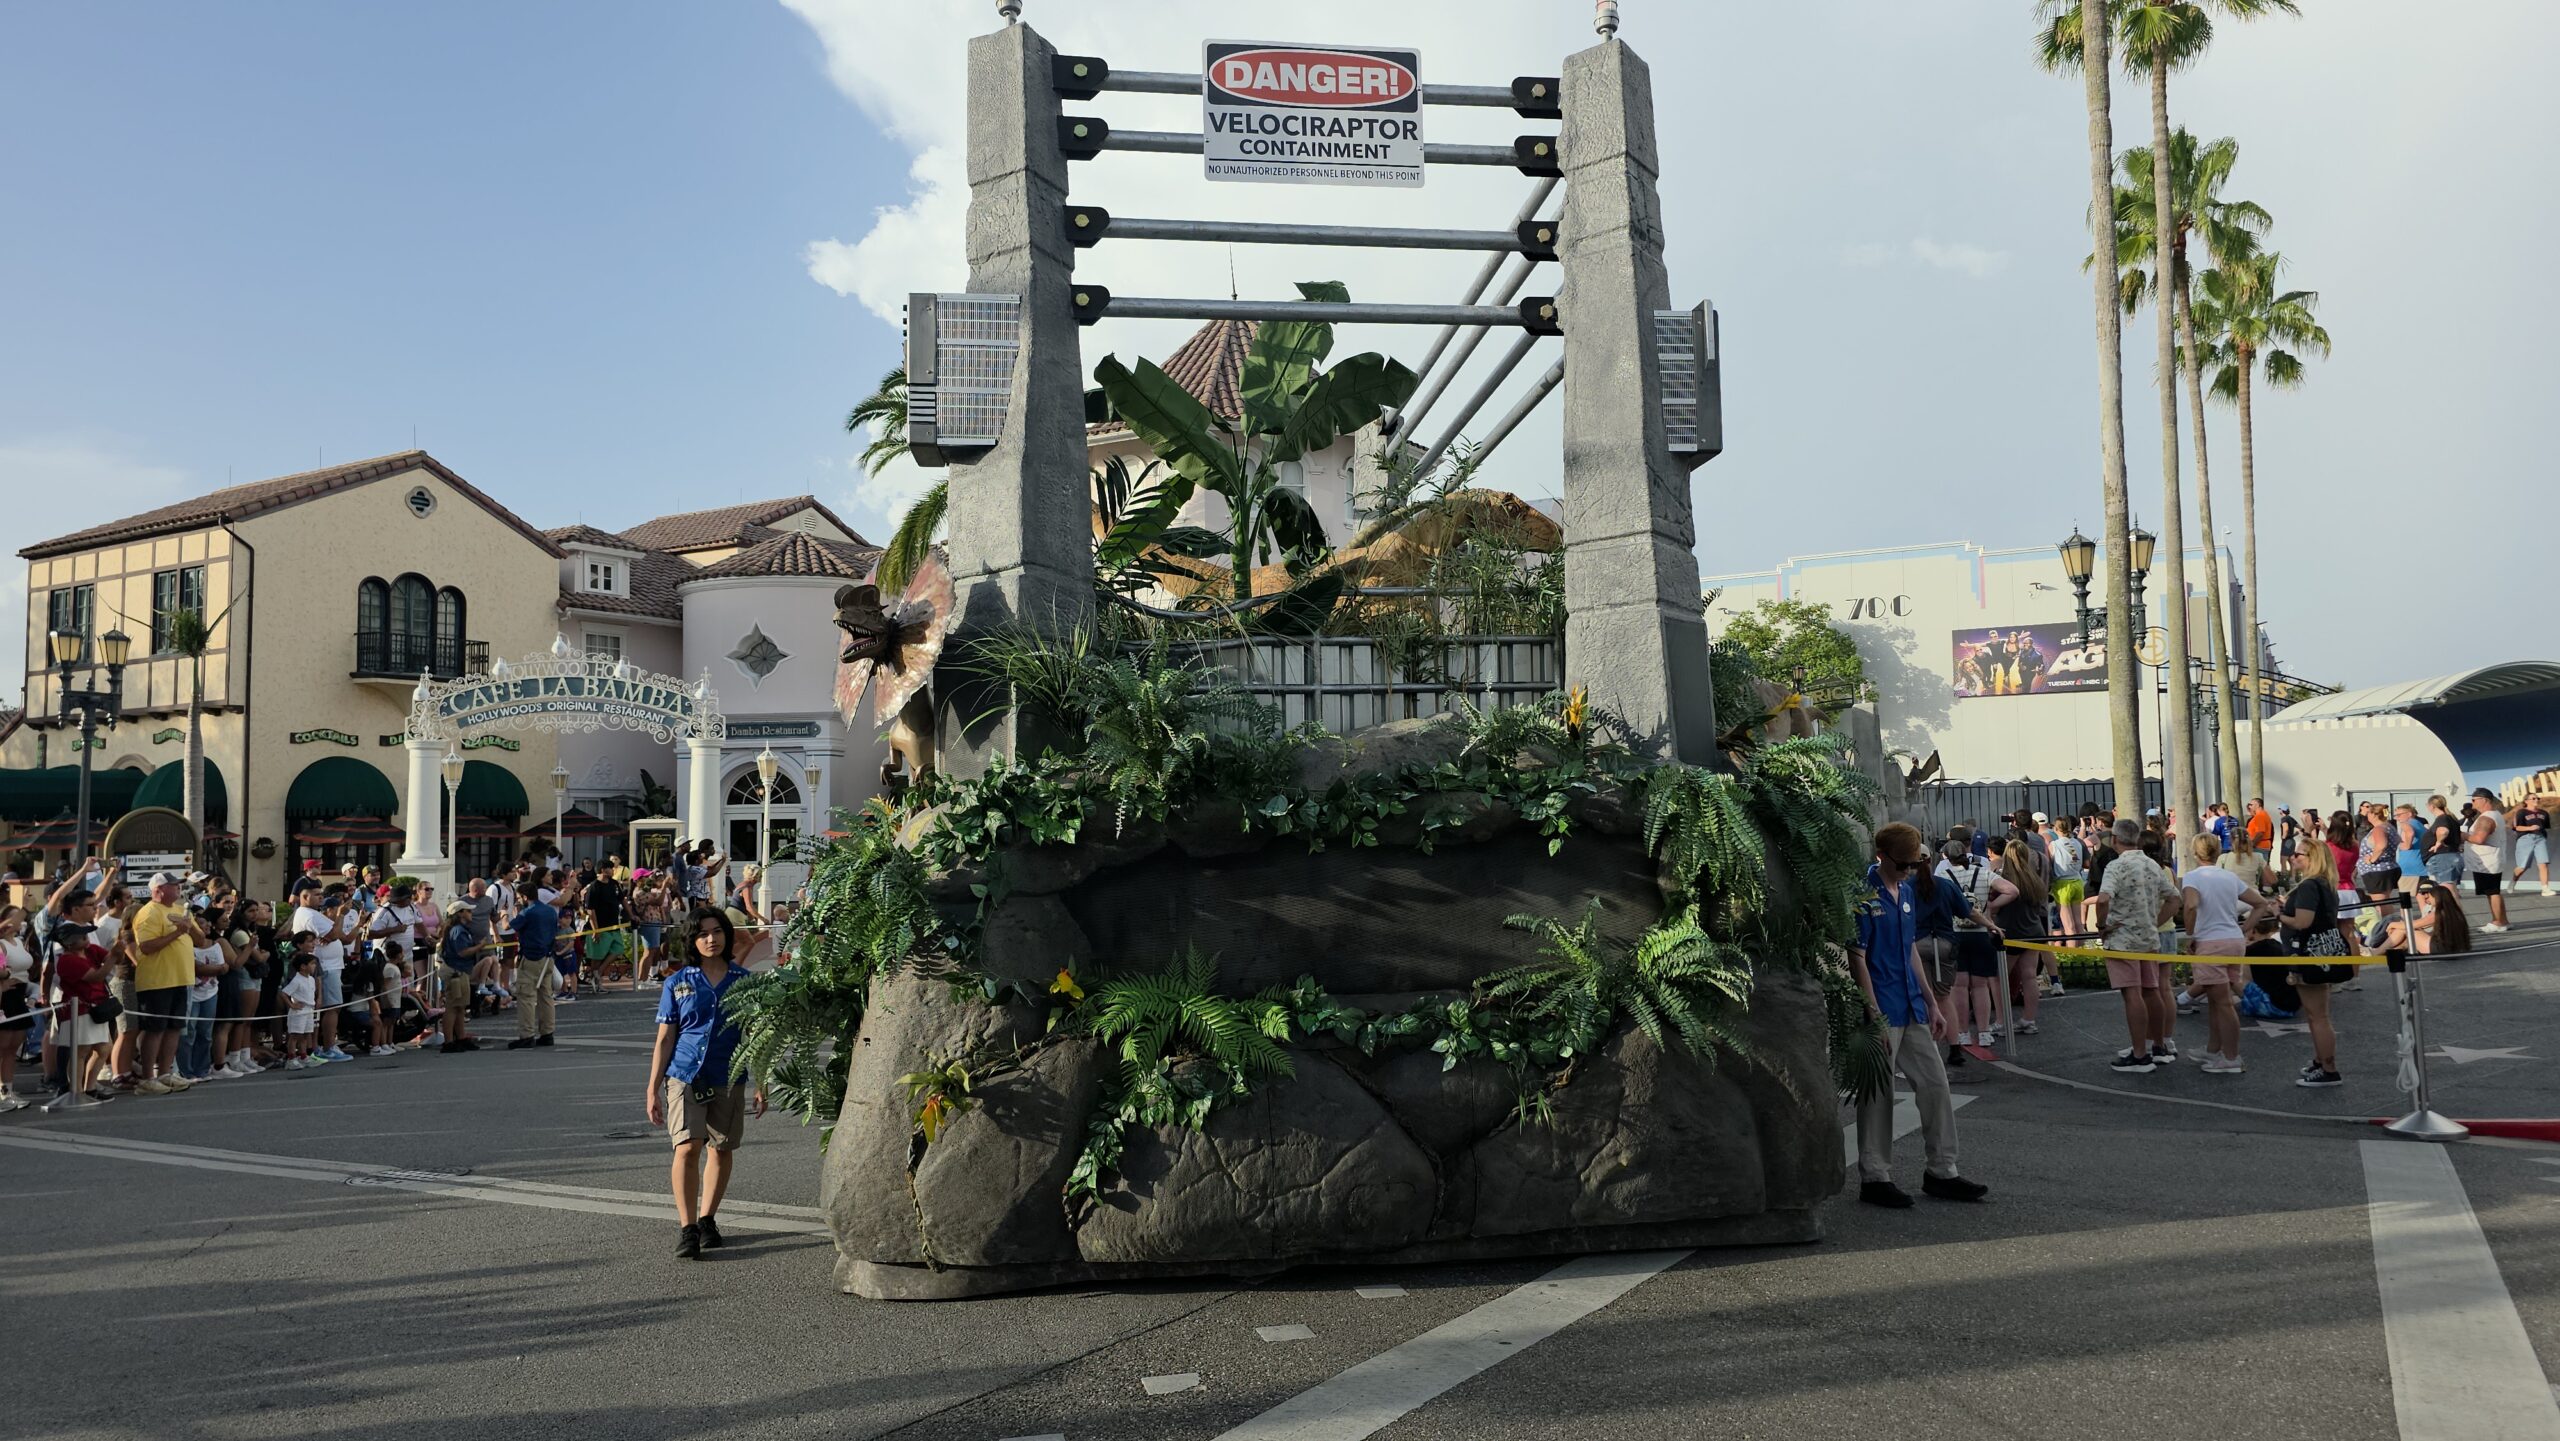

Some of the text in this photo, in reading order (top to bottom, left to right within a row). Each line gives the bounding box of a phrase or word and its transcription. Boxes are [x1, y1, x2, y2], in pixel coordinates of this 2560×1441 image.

[1224, 60, 1399, 96] DANGER!
[1208, 112, 1419, 141] VELOCIRAPTOR
[1239, 138, 1391, 160] CONTAINMENT
[1208, 165, 1420, 181] NO UNAUTHORIZED PERSONNEL BEYOND THIS POINT
[2047, 644, 2106, 675] AG
[449, 677, 683, 715] CAFE LA BAMBA
[467, 701, 666, 725] HOLLYWOOD'S ORIGINAL RESTAURANT
[294, 730, 358, 746] COCKTAILS
[731, 727, 760, 736] Bamba
[762, 725, 809, 736] Restaurant
